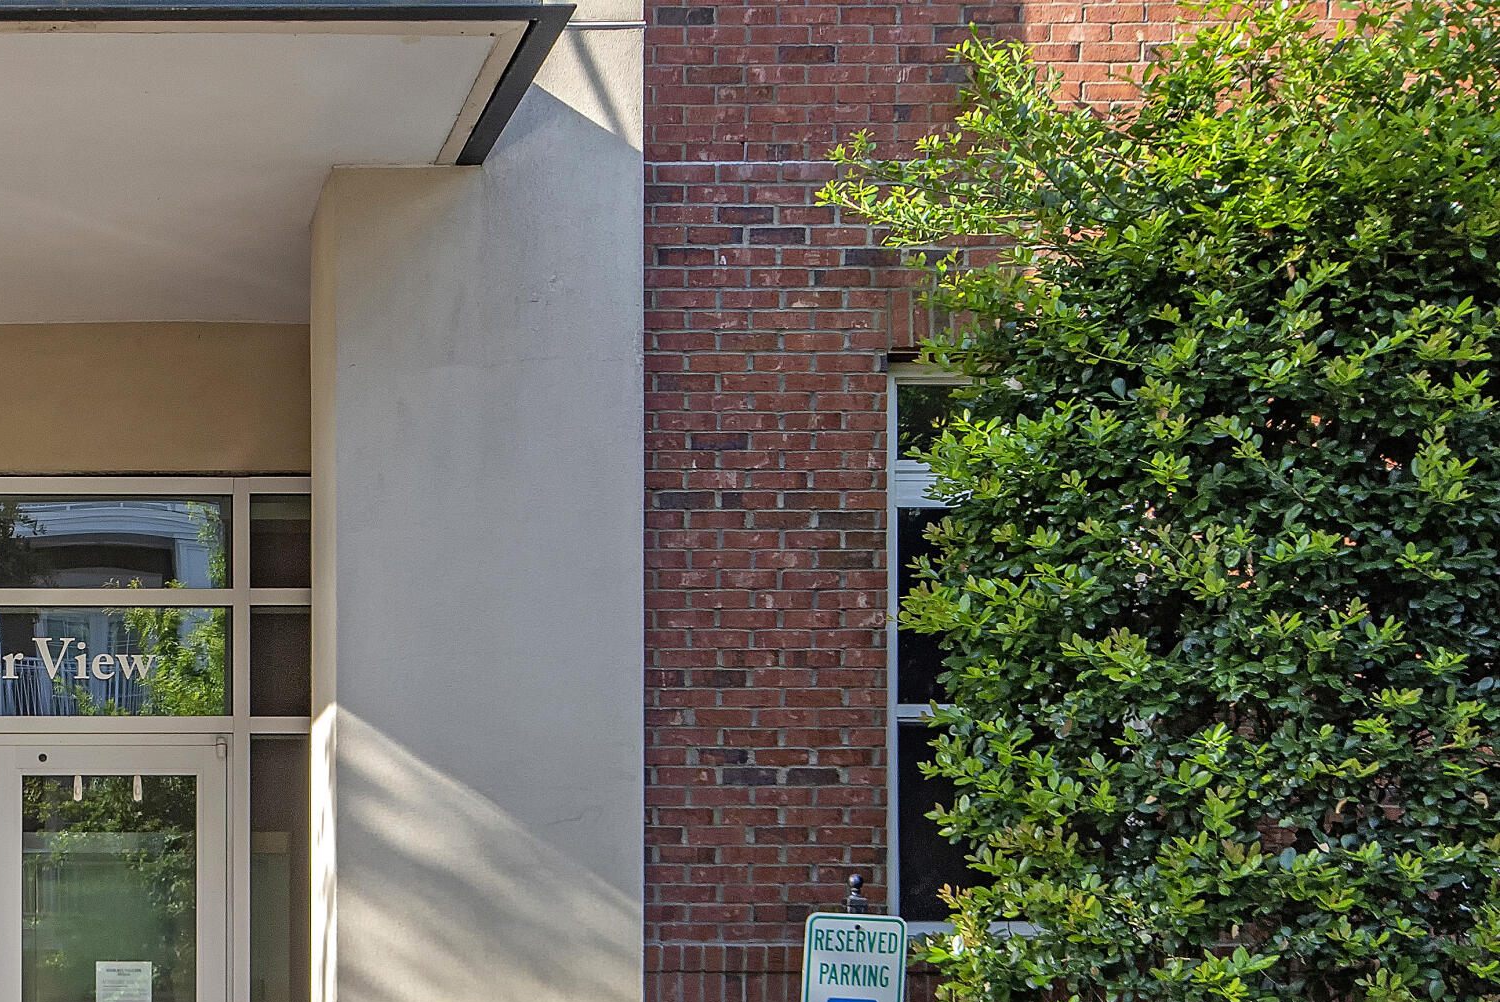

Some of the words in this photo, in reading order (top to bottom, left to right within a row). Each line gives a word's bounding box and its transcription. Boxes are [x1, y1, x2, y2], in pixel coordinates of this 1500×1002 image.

[31, 637, 156, 680] View
[814, 928, 898, 954] RESERVED
[819, 962, 890, 988] PARKING
